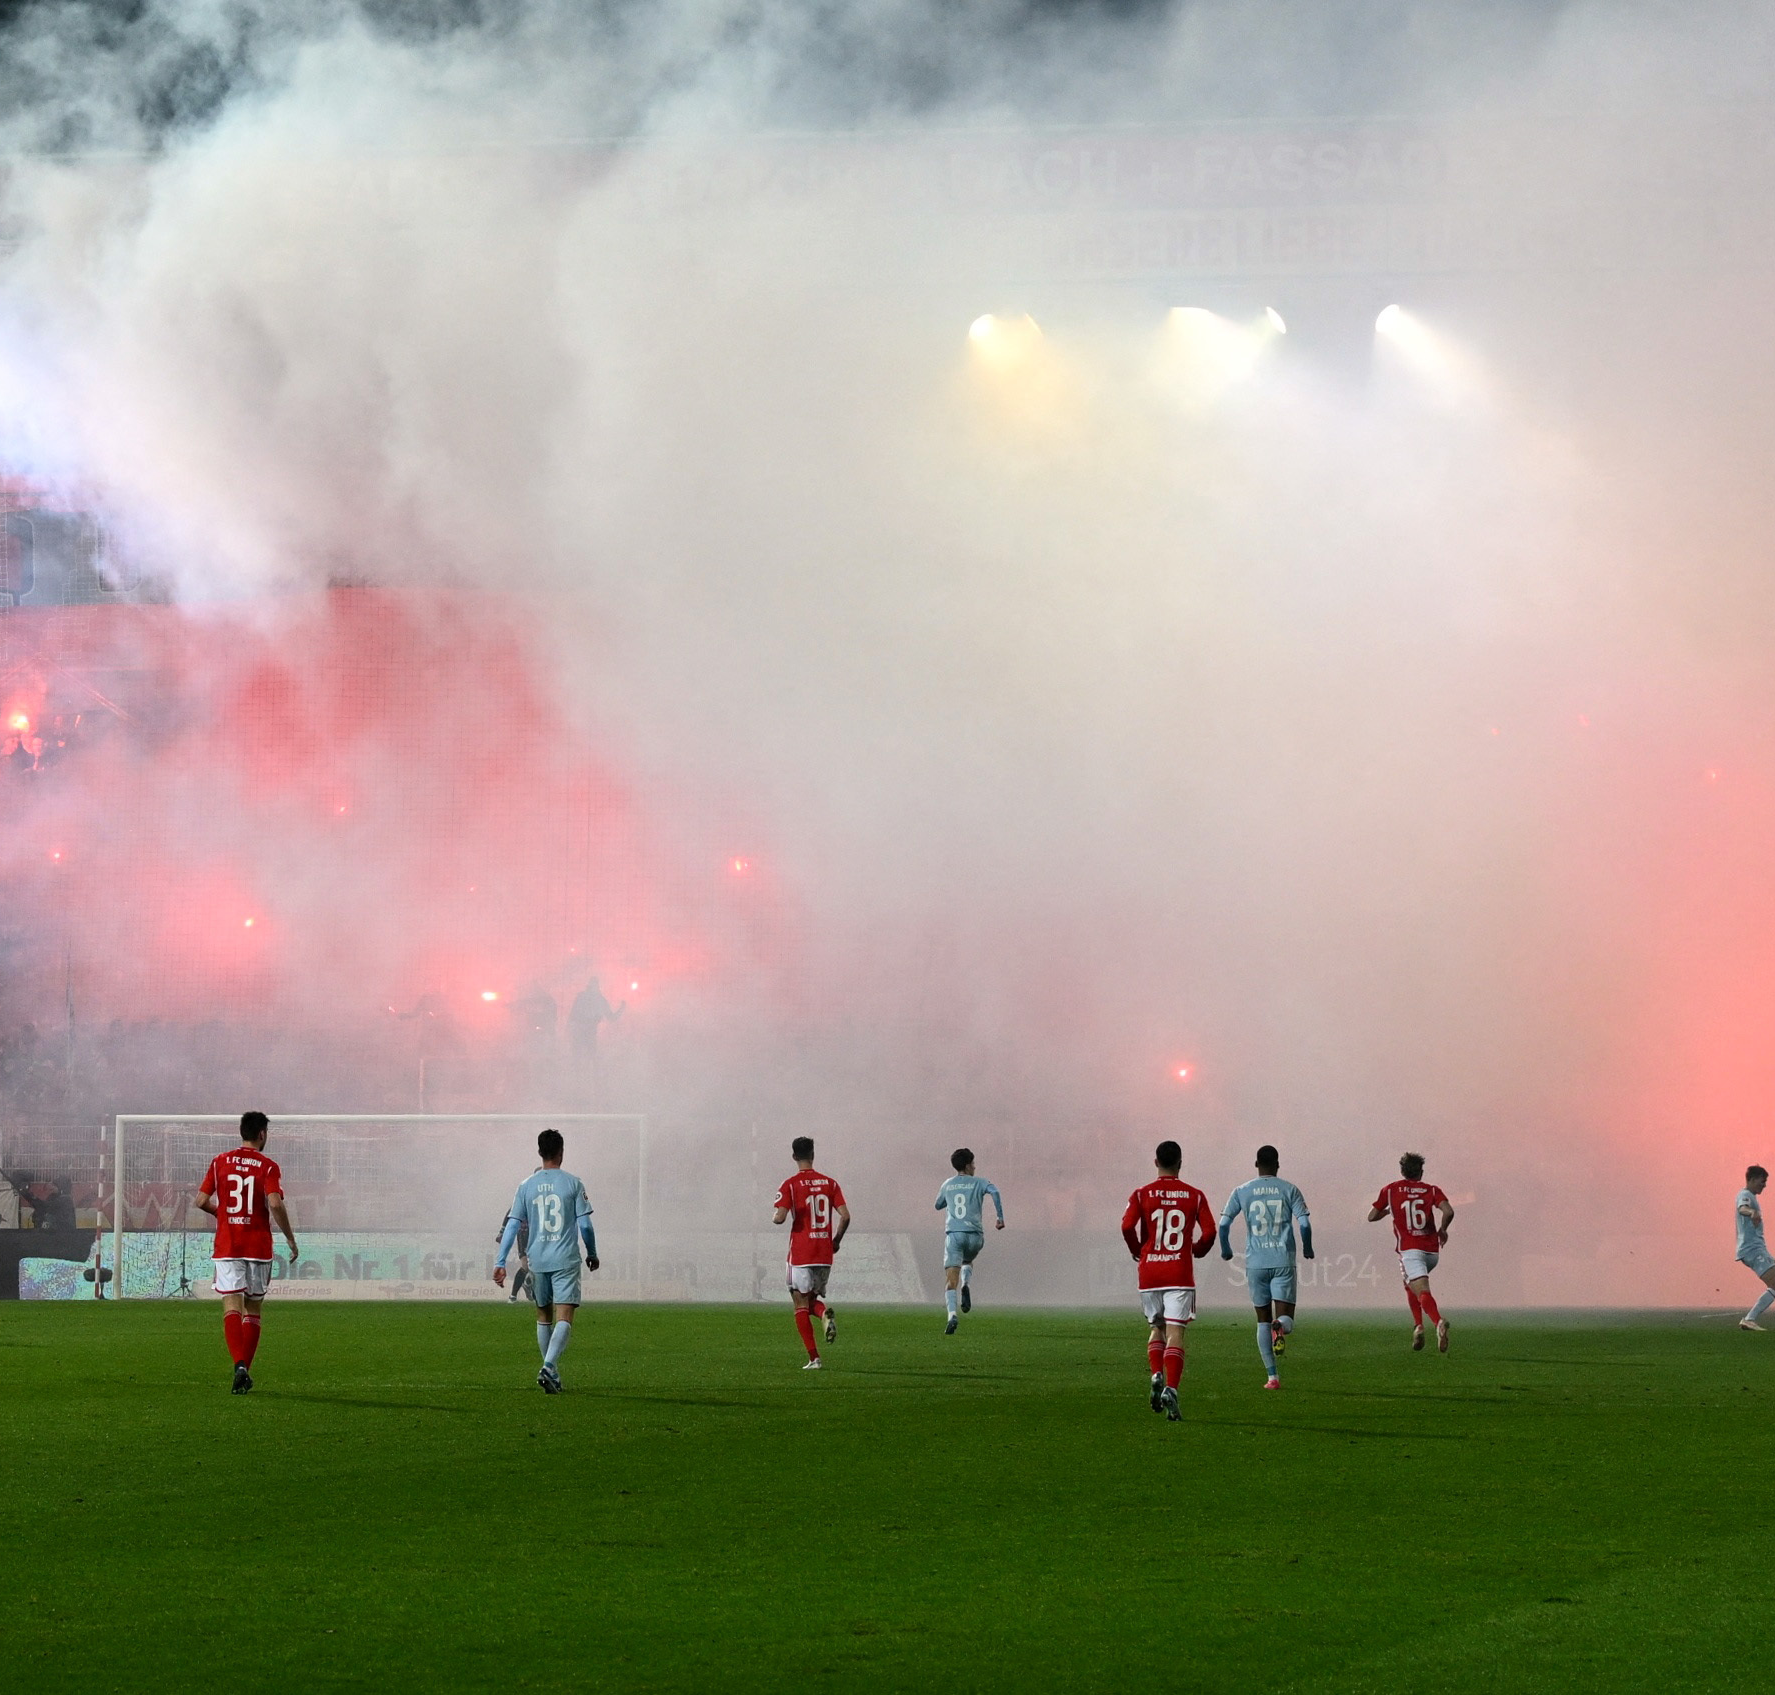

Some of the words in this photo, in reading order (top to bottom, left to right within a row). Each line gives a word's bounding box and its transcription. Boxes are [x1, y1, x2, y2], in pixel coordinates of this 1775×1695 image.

[232, 1156, 241, 1164] FC
[226, 1173, 255, 1215] 31
[537, 1183, 554, 1193] UTH
[1155, 1189, 1164, 1197] FC
[1165, 1190, 1190, 1199] UNION
[1253, 1186, 1280, 1196] MAINA
[532, 1193, 562, 1233] 13
[805, 1193, 830, 1229] 19
[953, 1193, 967, 1220] 8
[1249, 1199, 1283, 1237] 37
[1400, 1199, 1427, 1231] 16
[1151, 1208, 1186, 1252] 18
[392, 1254, 409, 1281] 1
[420, 1252, 476, 1281] für
[1226, 1253, 1381, 1288] Sut24
[417, 1285, 497, 1297] TotalEnergies
